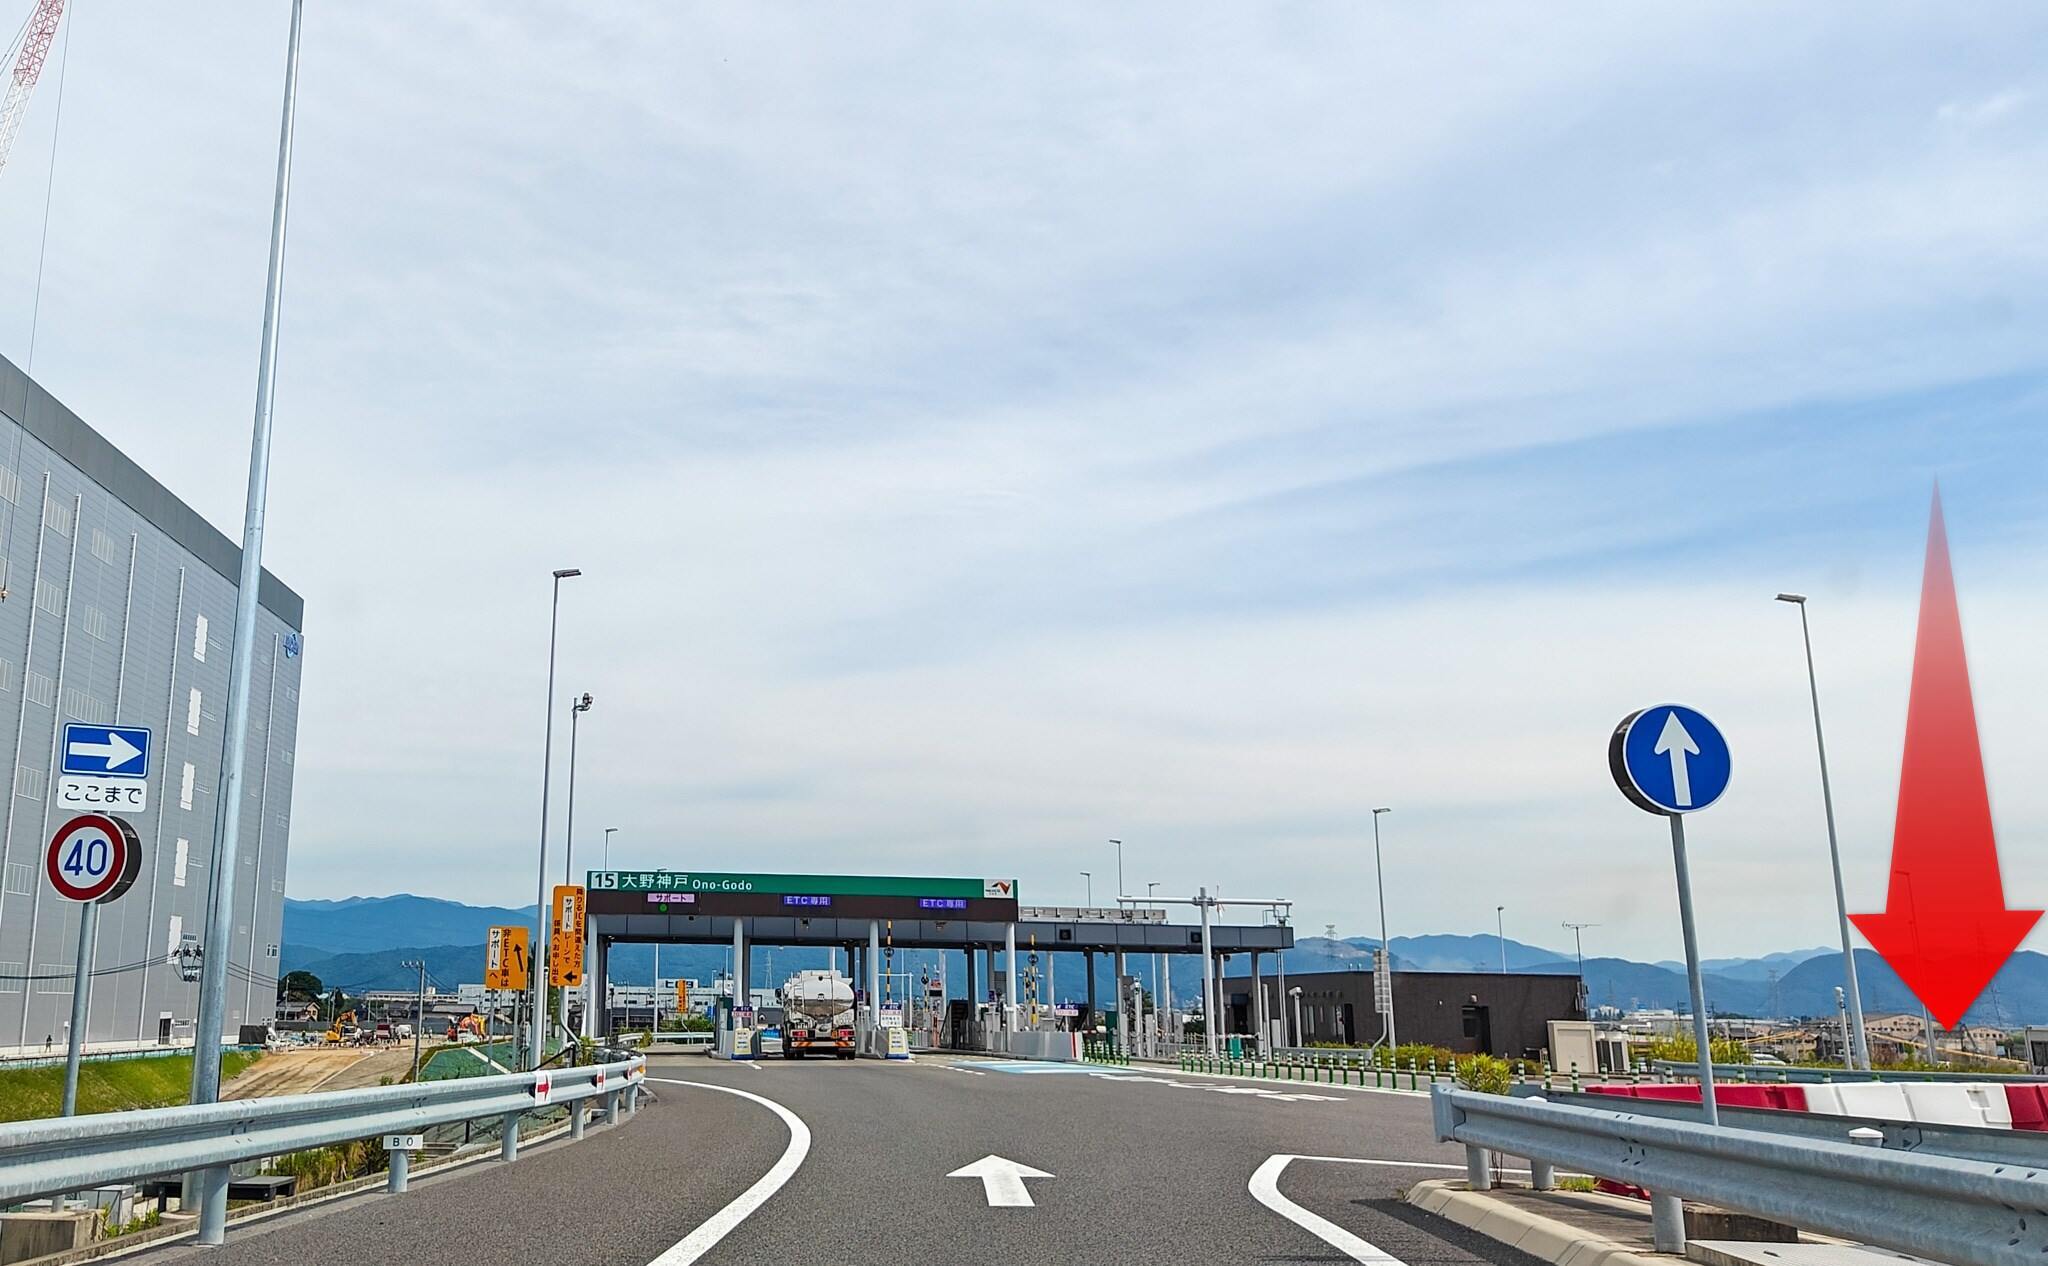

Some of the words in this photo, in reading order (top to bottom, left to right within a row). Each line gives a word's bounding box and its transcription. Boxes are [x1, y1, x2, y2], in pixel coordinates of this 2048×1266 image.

[64, 784, 142, 804] ここまで
[64, 838, 108, 876] 40
[594, 873, 615, 888] 15
[621, 873, 689, 889] 大野神戸
[692, 879, 753, 891] Ono-Godo
[655, 894, 687, 902] サポート
[501, 928, 511, 987] 非ETC車は
